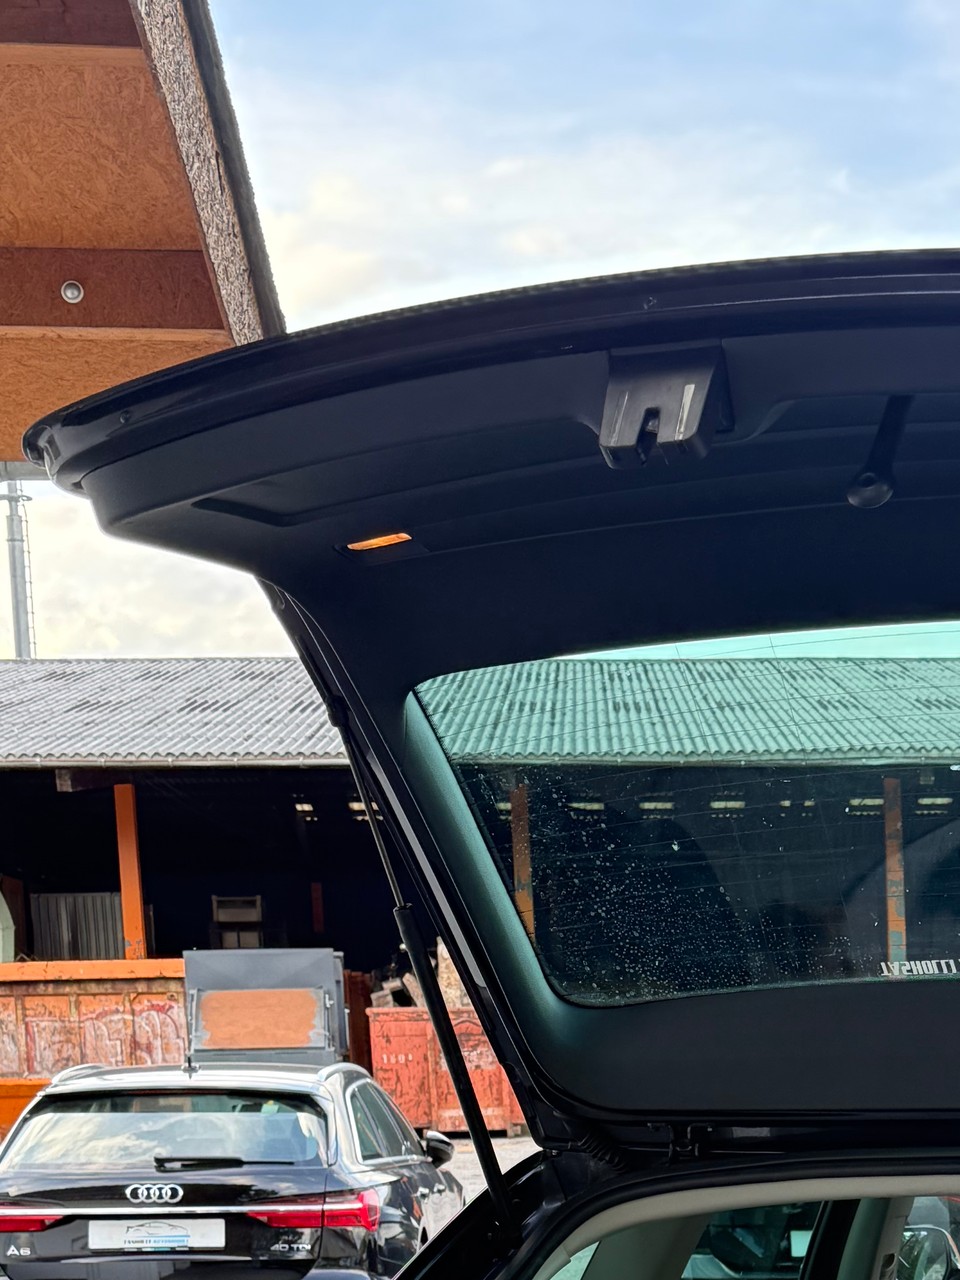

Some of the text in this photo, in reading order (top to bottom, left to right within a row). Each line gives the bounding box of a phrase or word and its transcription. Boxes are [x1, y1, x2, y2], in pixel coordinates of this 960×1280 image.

[6, 1244, 31, 1256] A6
[270, 1243, 312, 1252] 40 TDI
